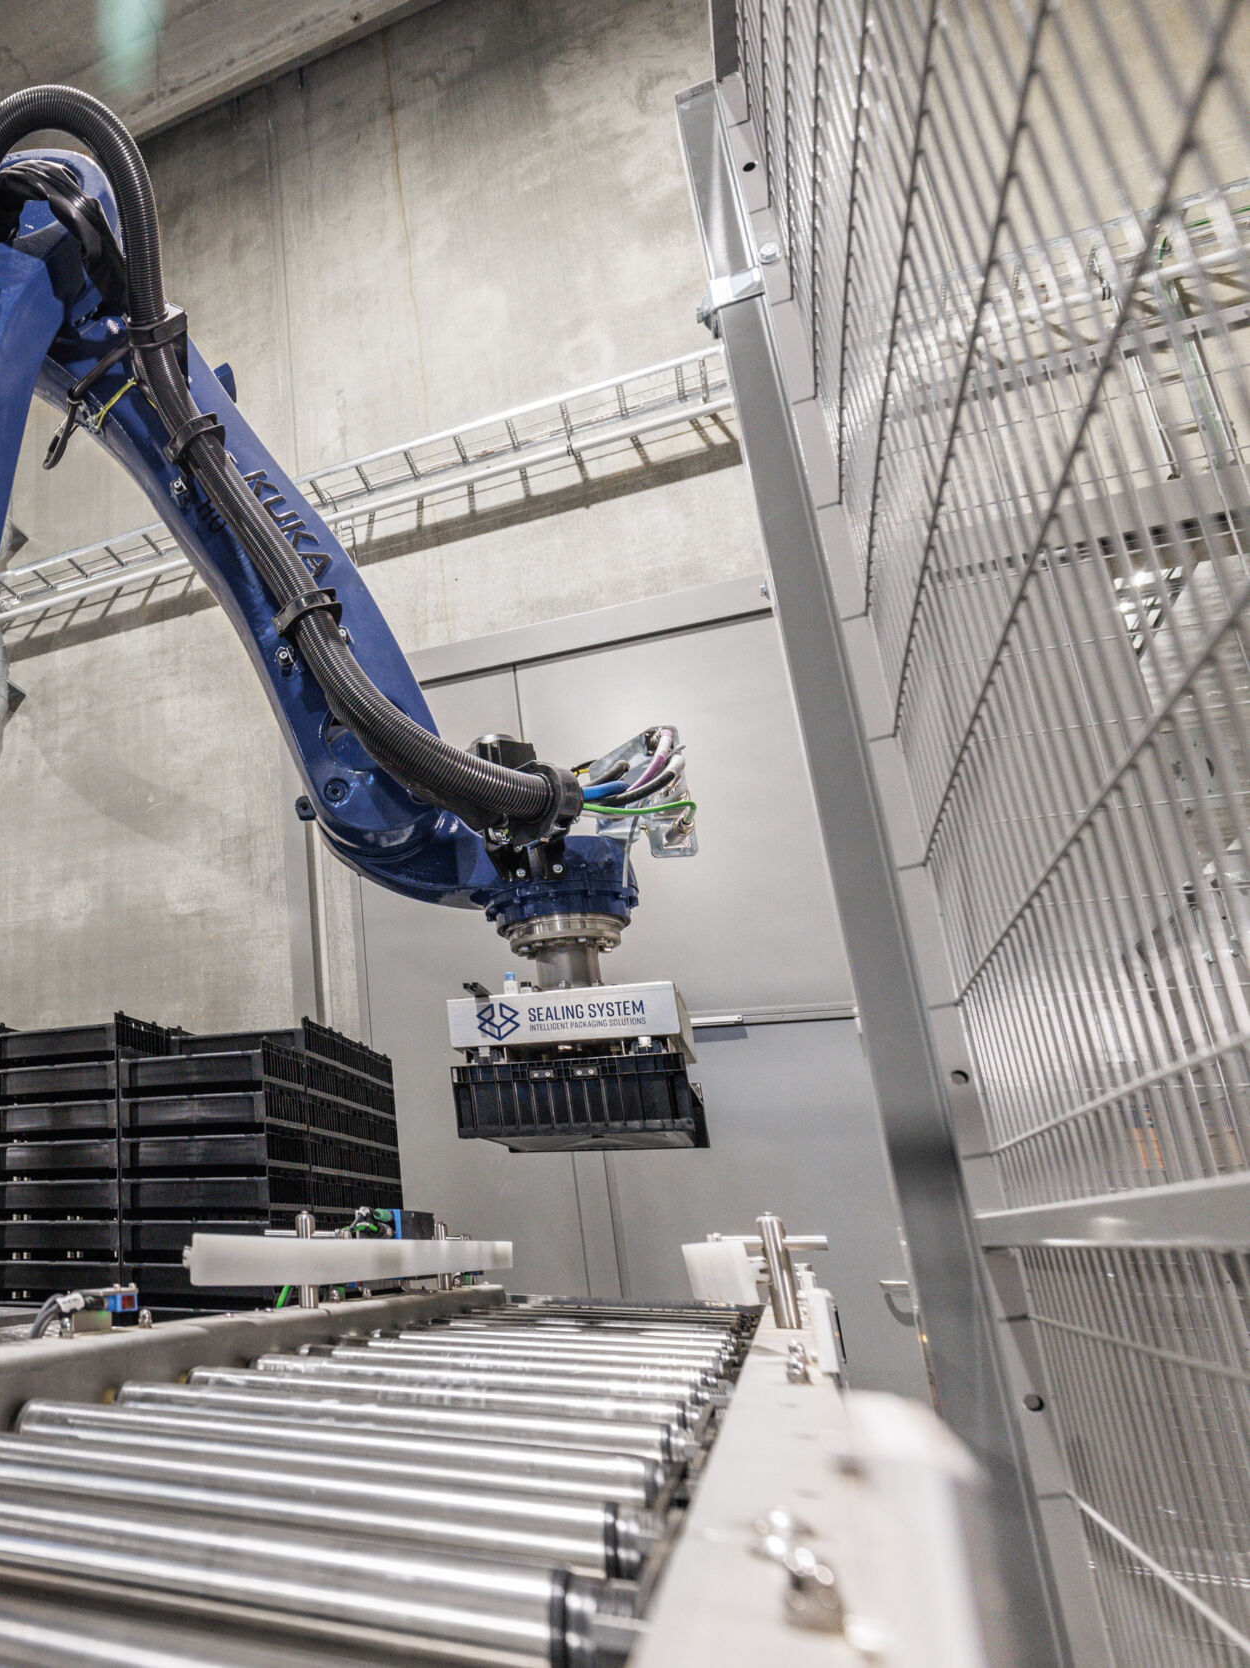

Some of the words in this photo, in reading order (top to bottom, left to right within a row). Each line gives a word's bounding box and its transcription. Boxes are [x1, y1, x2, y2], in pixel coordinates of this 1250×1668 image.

[243, 469, 333, 578] KUKA
[527, 1004, 584, 1022] SEALING
[587, 1000, 645, 1018] SYSTEM
[529, 1022, 568, 1032] INTELLIGENT
[570, 1020, 608, 1029] PACKAGING
[609, 1017, 647, 1027] SOLUTIONS
